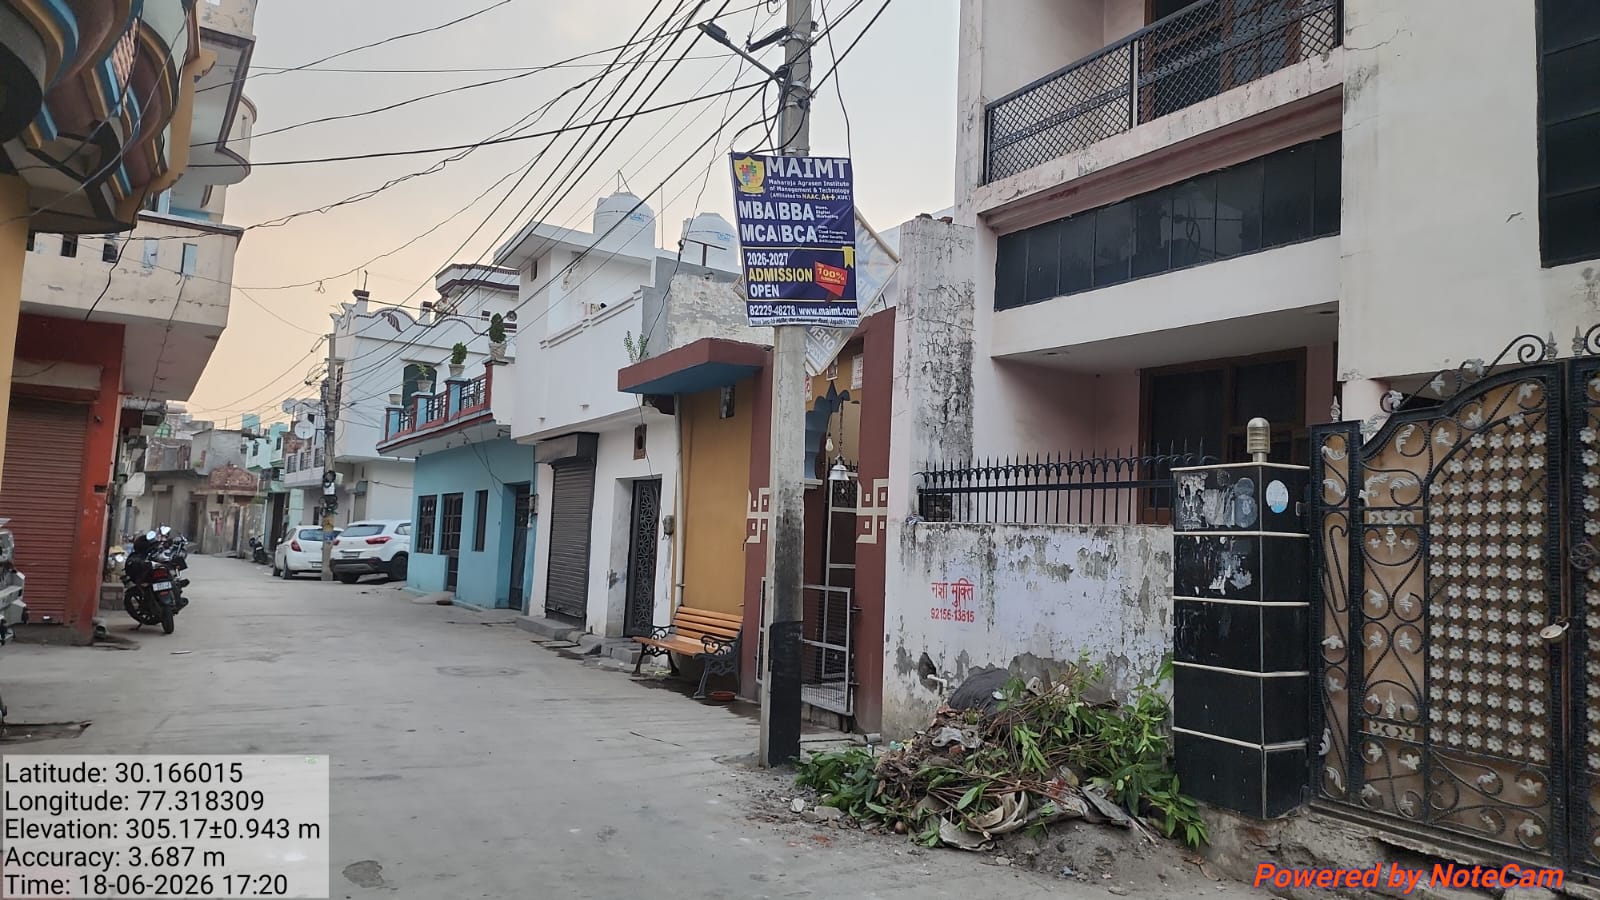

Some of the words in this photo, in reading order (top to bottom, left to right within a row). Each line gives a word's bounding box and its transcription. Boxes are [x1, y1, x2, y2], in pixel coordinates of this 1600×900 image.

[766, 157, 849, 179] MAIMT
[747, 252, 789, 266] 2026-2027
[748, 267, 813, 282] ADMISSION
[816, 267, 845, 281] 100%
[750, 284, 780, 297] OPEN
[798, 306, 858, 316] www.maimt.com
[931, 582, 949, 600] नशा
[950, 577, 975, 608] मुक्ति
